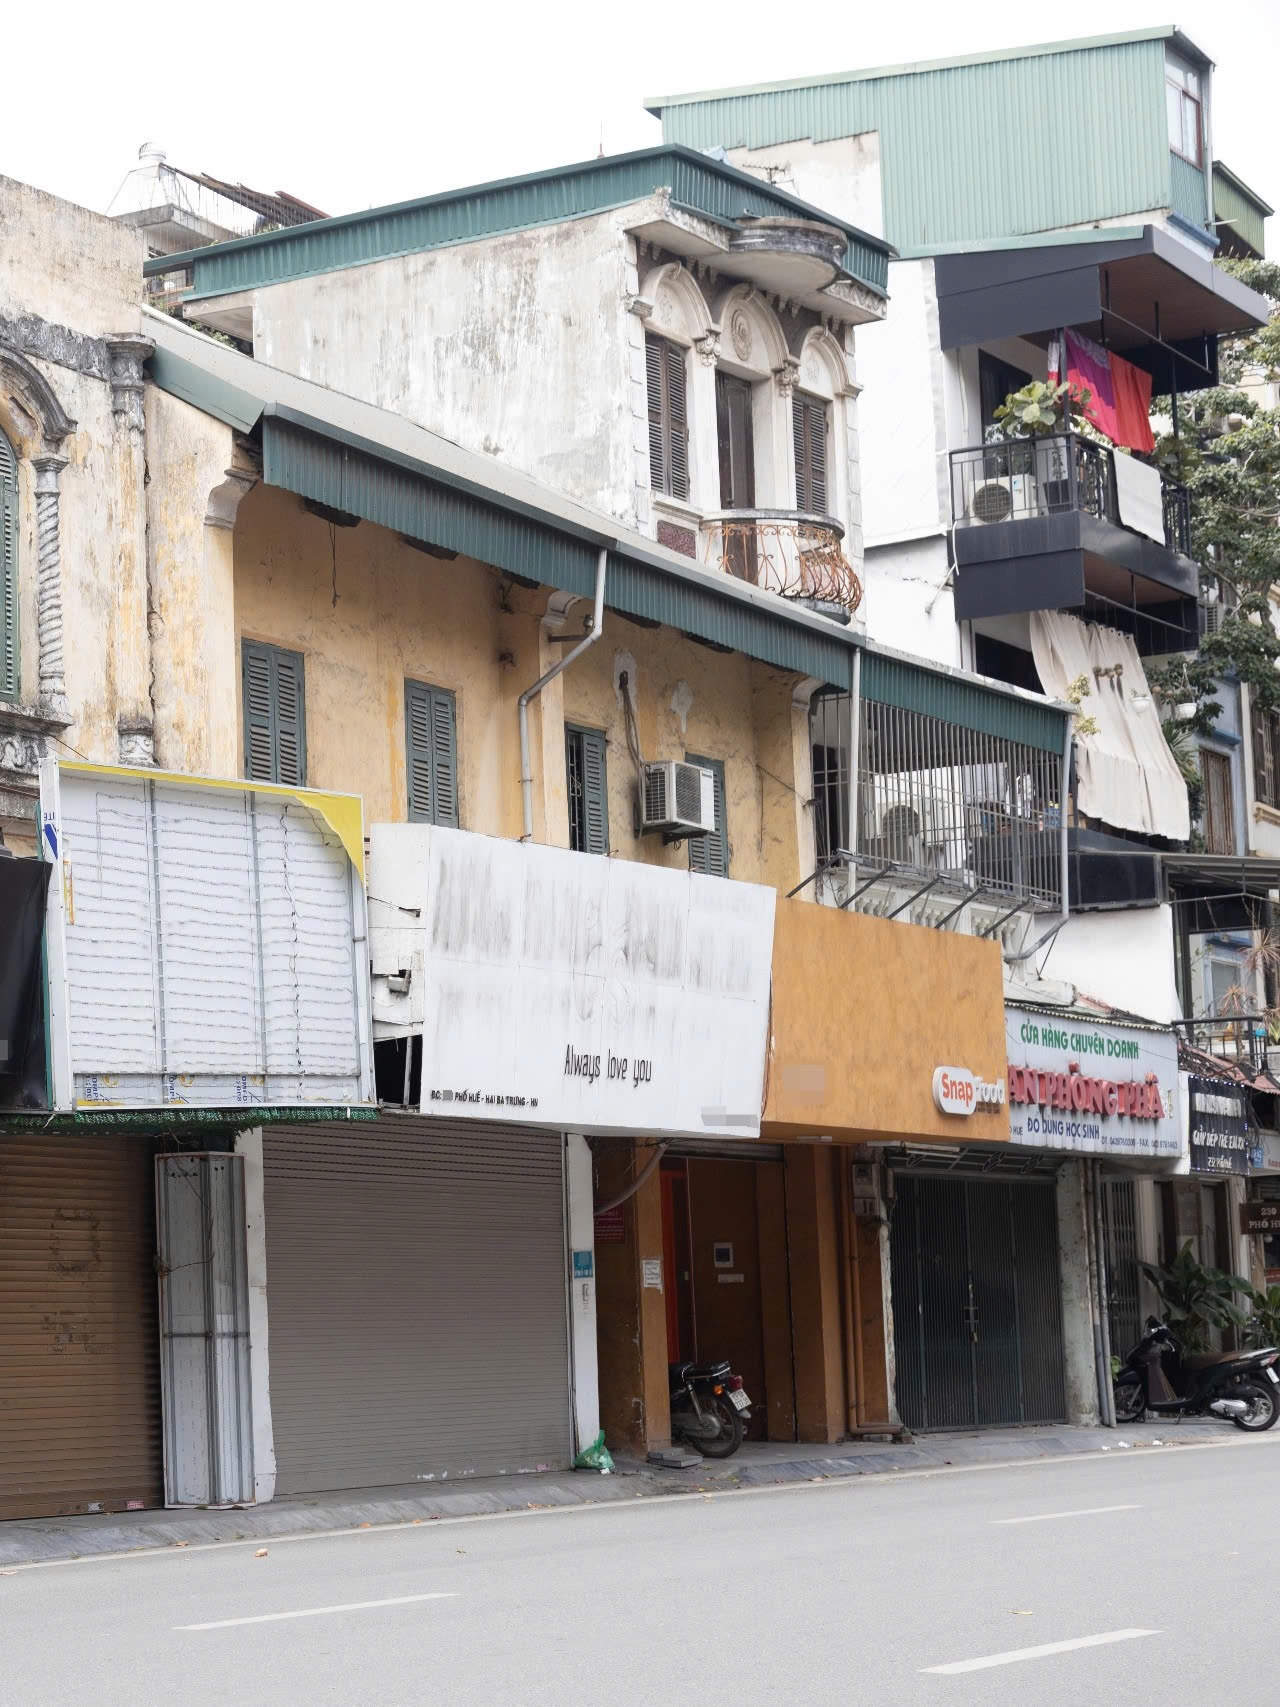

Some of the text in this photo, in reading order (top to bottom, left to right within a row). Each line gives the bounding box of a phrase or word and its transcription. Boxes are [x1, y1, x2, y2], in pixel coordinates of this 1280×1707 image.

[1042, 1023, 1069, 1050] HÀNG
[1070, 1032, 1105, 1056] CHUYÊN
[1107, 1039, 1139, 1060] DOANH
[563, 1044, 652, 1088] Always love you
[485, 1095, 496, 1104] HAI
[1065, 1123, 1081, 1144] HỌC
[1082, 1125, 1100, 1139] SINH
[1261, 1207, 1277, 1216] 230
